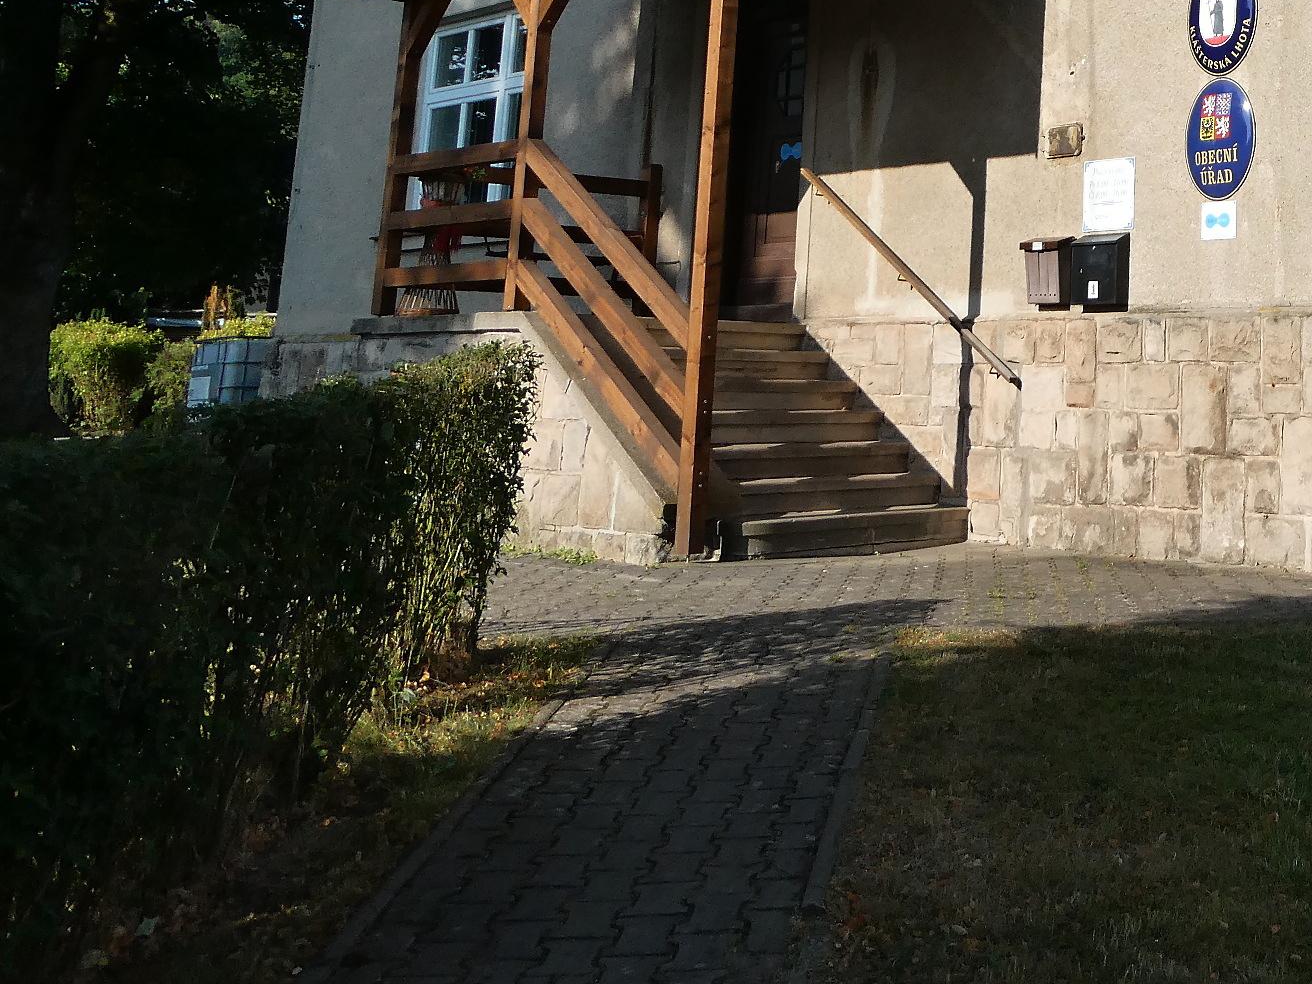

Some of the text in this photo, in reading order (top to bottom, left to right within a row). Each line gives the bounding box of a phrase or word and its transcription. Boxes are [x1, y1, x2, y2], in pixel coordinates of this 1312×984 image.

[1189, 17, 1252, 70] KLÁŠTERSKÁ LHOTA
[1194, 142, 1238, 166] OBECNÍ
[1200, 166, 1233, 186] ÚŘAD
